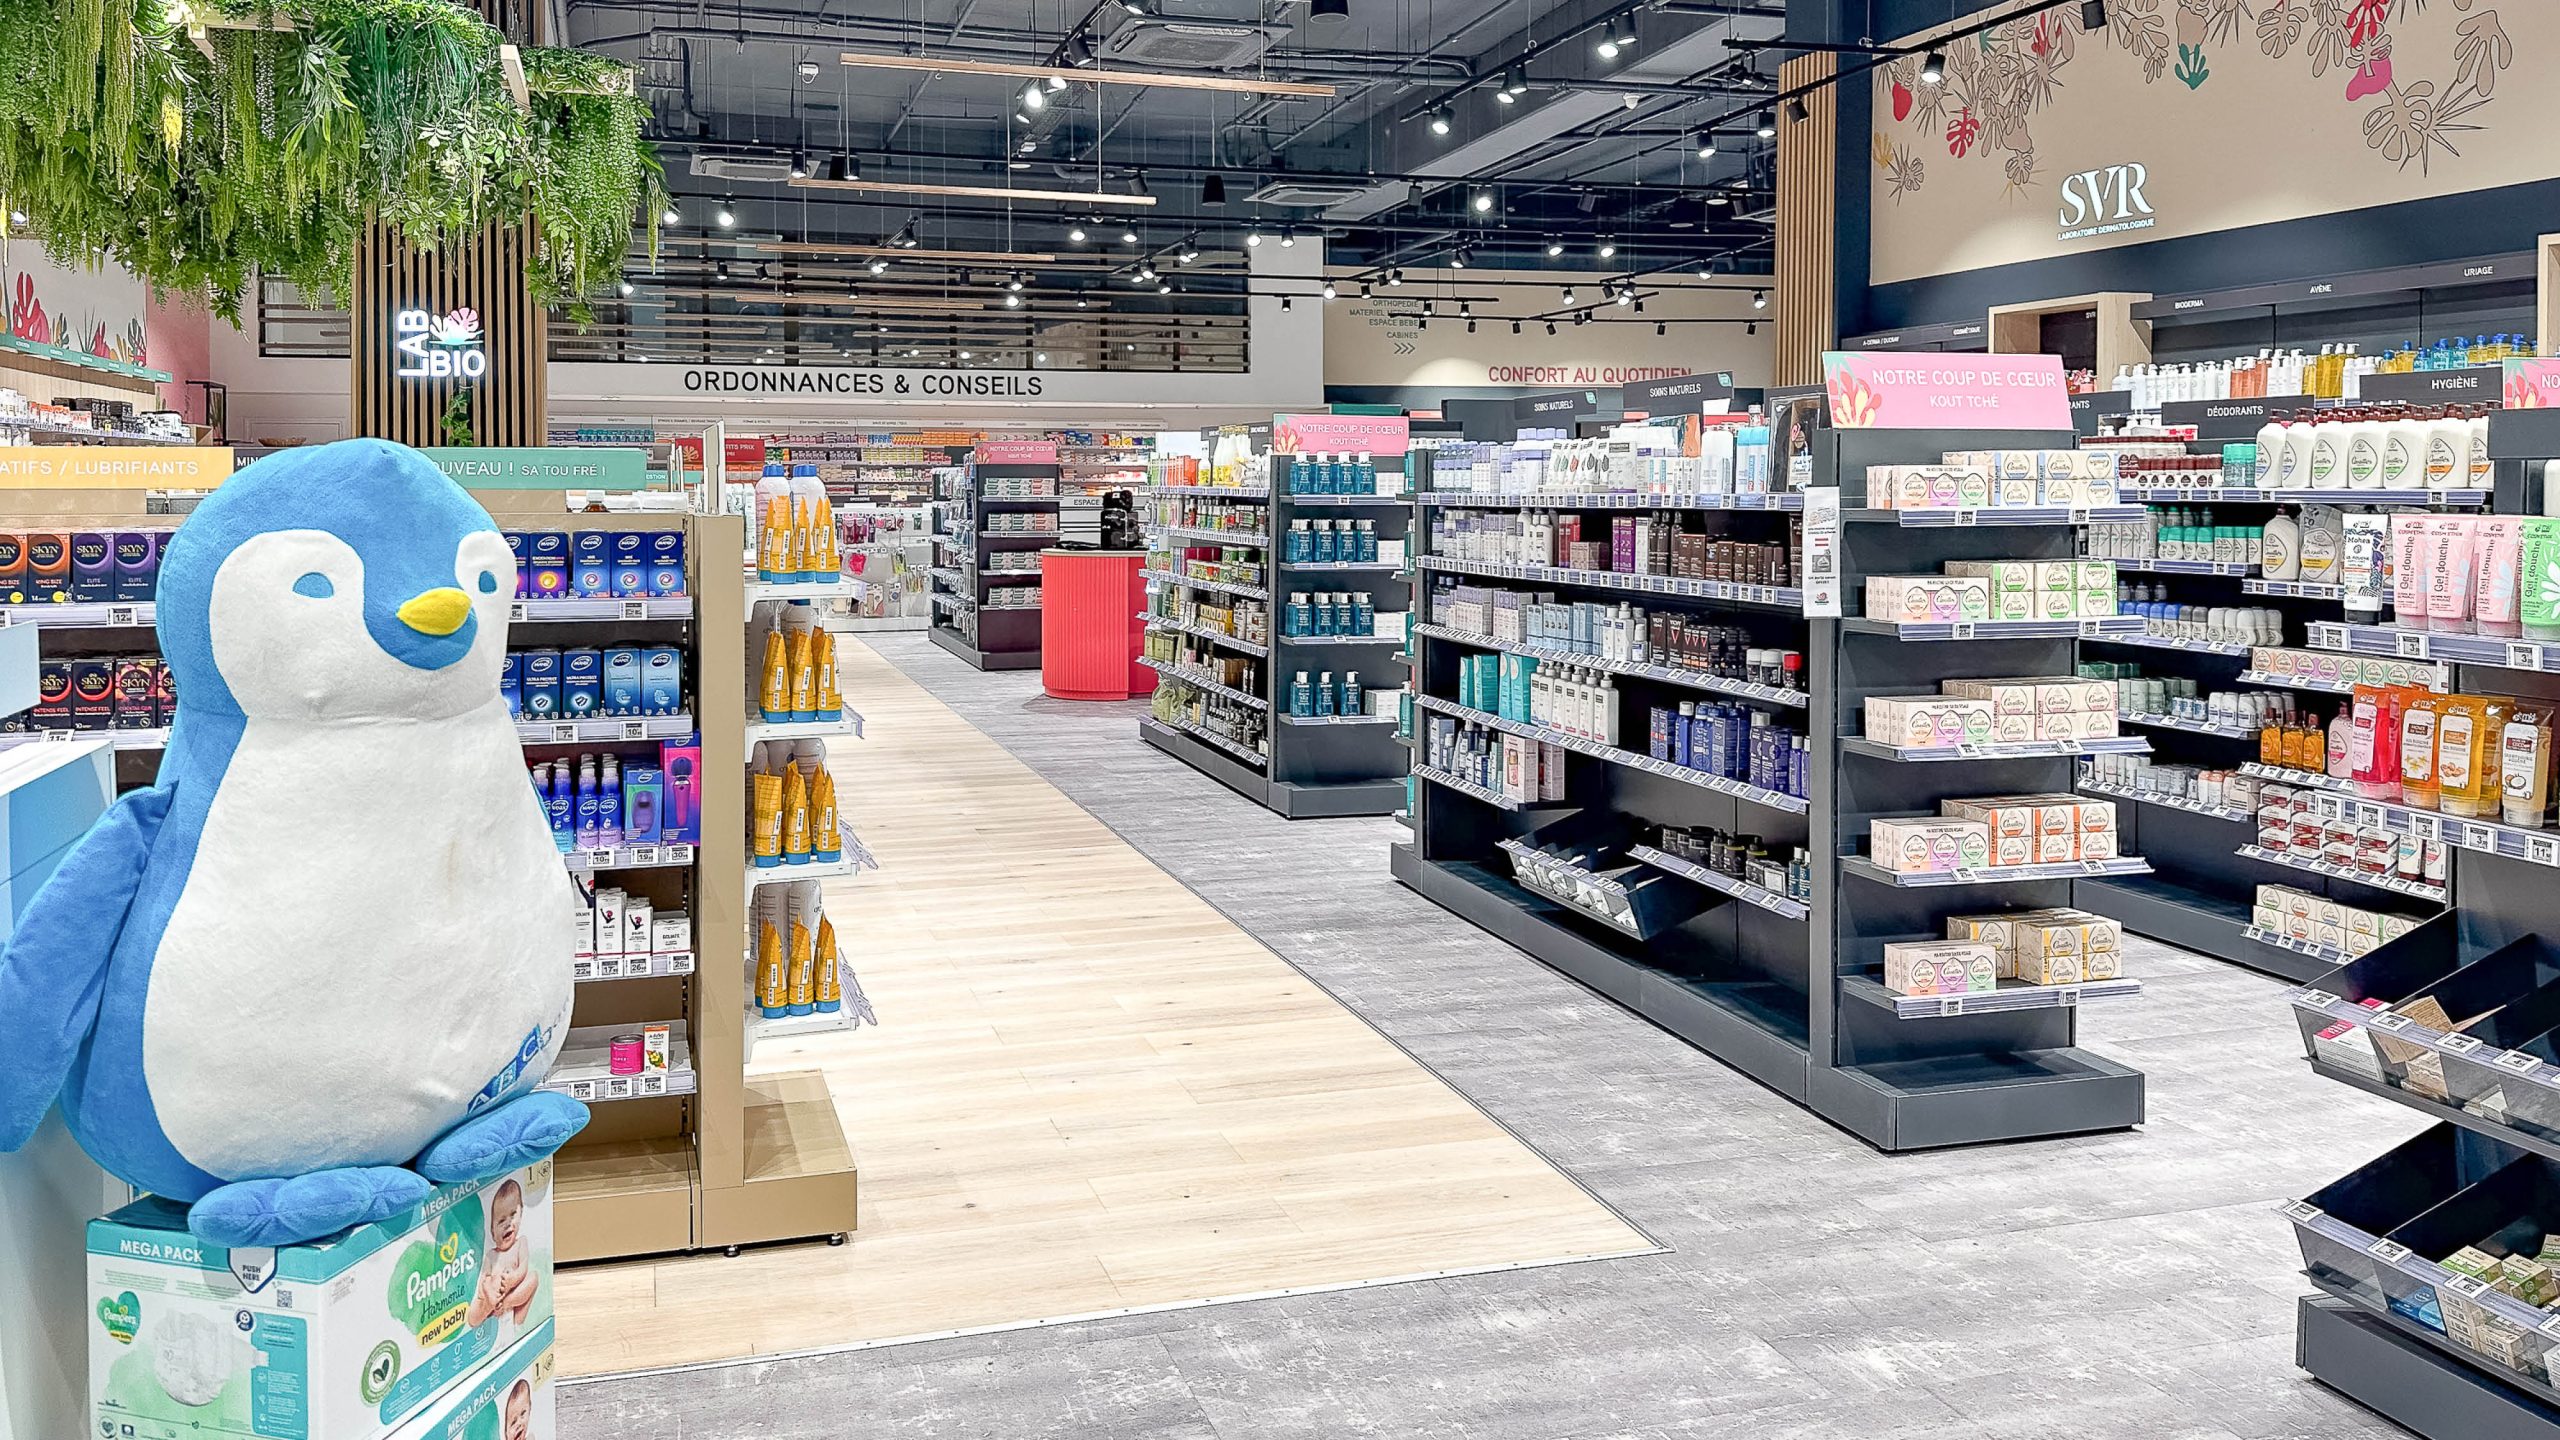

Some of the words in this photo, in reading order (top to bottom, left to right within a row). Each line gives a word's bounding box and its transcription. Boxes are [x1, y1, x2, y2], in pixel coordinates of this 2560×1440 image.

[2060, 162, 2154, 227] SVR
[2057, 227, 2098, 241] LABORATOIRE
[2098, 217, 2155, 235] DERMATOLOGIQUE
[2463, 266, 2493, 277] URIAGE
[2309, 283, 2332, 294] AVÈNE
[1349, 308, 1385, 316] MATERIEL
[2174, 299, 2204, 310] BIODERMA
[1399, 319, 1419, 327] BEBE
[1386, 331, 1419, 339] CABINES
[397, 309, 430, 377] LAB
[430, 349, 486, 378] BIO
[1488, 366, 1568, 383] CONFORT
[1573, 367, 1597, 383] AU
[1872, 369, 1928, 386] NOTRE
[1932, 369, 1976, 386] COUP
[1981, 371, 2002, 387] DE
[2007, 371, 2058, 388] CŒUR
[684, 370, 884, 393] ORDONNANCES
[894, 373, 910, 393] &
[922, 374, 1043, 396] CONSEILS
[1650, 387, 1668, 398] SOINS
[1668, 382, 1701, 396] NATURELS
[2431, 375, 2478, 390] HYGIÈNE
[1534, 402, 1549, 412] SOINS
[1549, 400, 1574, 411] NATURELS
[1930, 395, 1965, 408] KOUT
[1967, 393, 1999, 408] TCHÉ
[2206, 405, 2264, 417] DÉODORANTS
[1299, 424, 1331, 433] NOTRE
[1332, 424, 1358, 433] COUP
[1360, 425, 1373, 433] DE
[1375, 425, 1404, 434] CŒUR
[1350, 436, 1369, 446] TCHÉ
[75, 461, 199, 476] LUBRIFIANTS
[521, 465, 539, 476] SA
[543, 465, 570, 476] TOU
[573, 462, 598, 476] FRÉ
[31, 545, 59, 555] SKYN
[76, 545, 104, 554] SKYN
[118, 545, 145, 554] SKYN
[2404, 536, 2415, 573] douche
[2437, 537, 2450, 574] douche
[2399, 573, 2410, 590] Gel
[2434, 575, 2445, 592] Gel
[81, 677, 107, 686] SKYN
[121, 678, 150, 688] SKYN
[420, 1195, 450, 1221] MEGA
[451, 1179, 481, 1201] PACK
[119, 1239, 161, 1258] MEGA
[163, 1245, 204, 1264] PACK
[242, 1264, 261, 1273] PUSH
[242, 1273, 260, 1282] HERE
[406, 1249, 475, 1309] Pampers
[419, 1285, 466, 1325] Harmonie
[103, 1307, 136, 1325] Pampers
[421, 1325, 442, 1346] new
[443, 1307, 467, 1333] baby
[447, 1405, 473, 1437] MEGA
[472, 1380, 497, 1408] PACK
